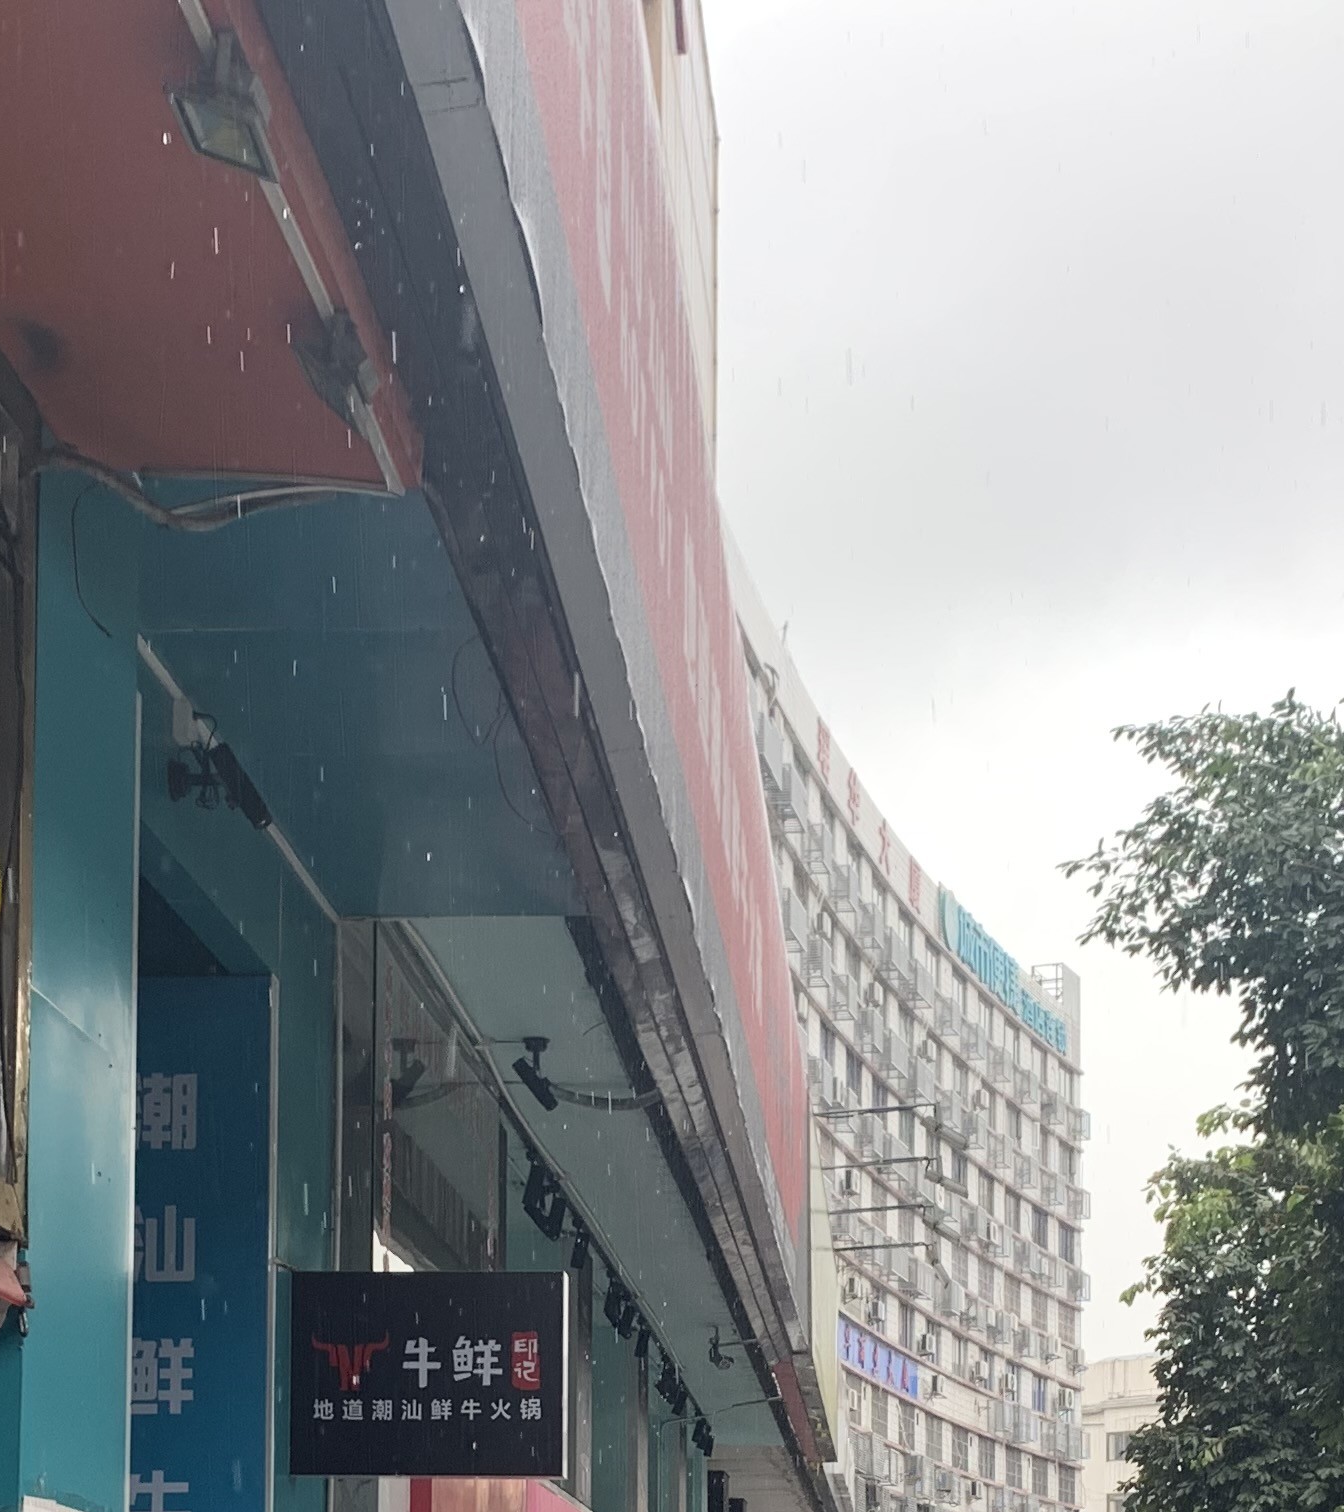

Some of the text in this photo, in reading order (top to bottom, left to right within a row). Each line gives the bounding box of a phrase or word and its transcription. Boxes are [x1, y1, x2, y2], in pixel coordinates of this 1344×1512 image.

[402, 1335, 504, 1388] 牛鲜
[513, 1338, 539, 1382] 印记
[312, 1398, 542, 1422] 地道潮汕鲜牛火锅
